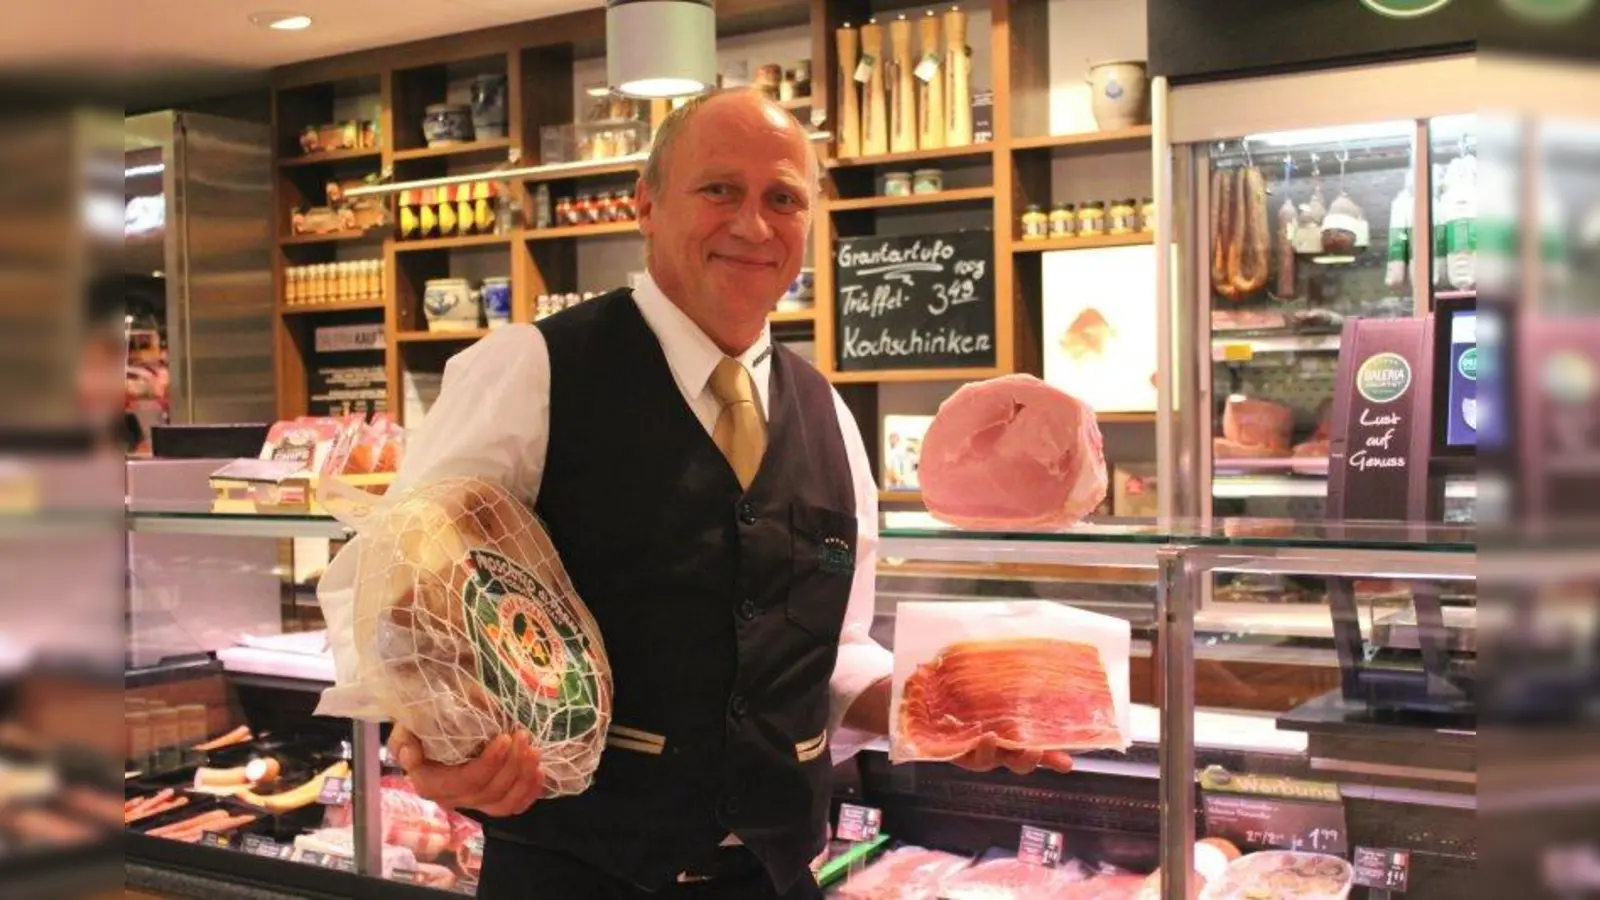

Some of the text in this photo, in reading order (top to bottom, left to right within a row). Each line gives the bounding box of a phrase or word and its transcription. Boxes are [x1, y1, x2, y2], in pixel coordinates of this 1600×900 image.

[1360, 408, 1401, 426] Lust
[1365, 428, 1395, 450] auf
[1349, 450, 1406, 472] Genuss
